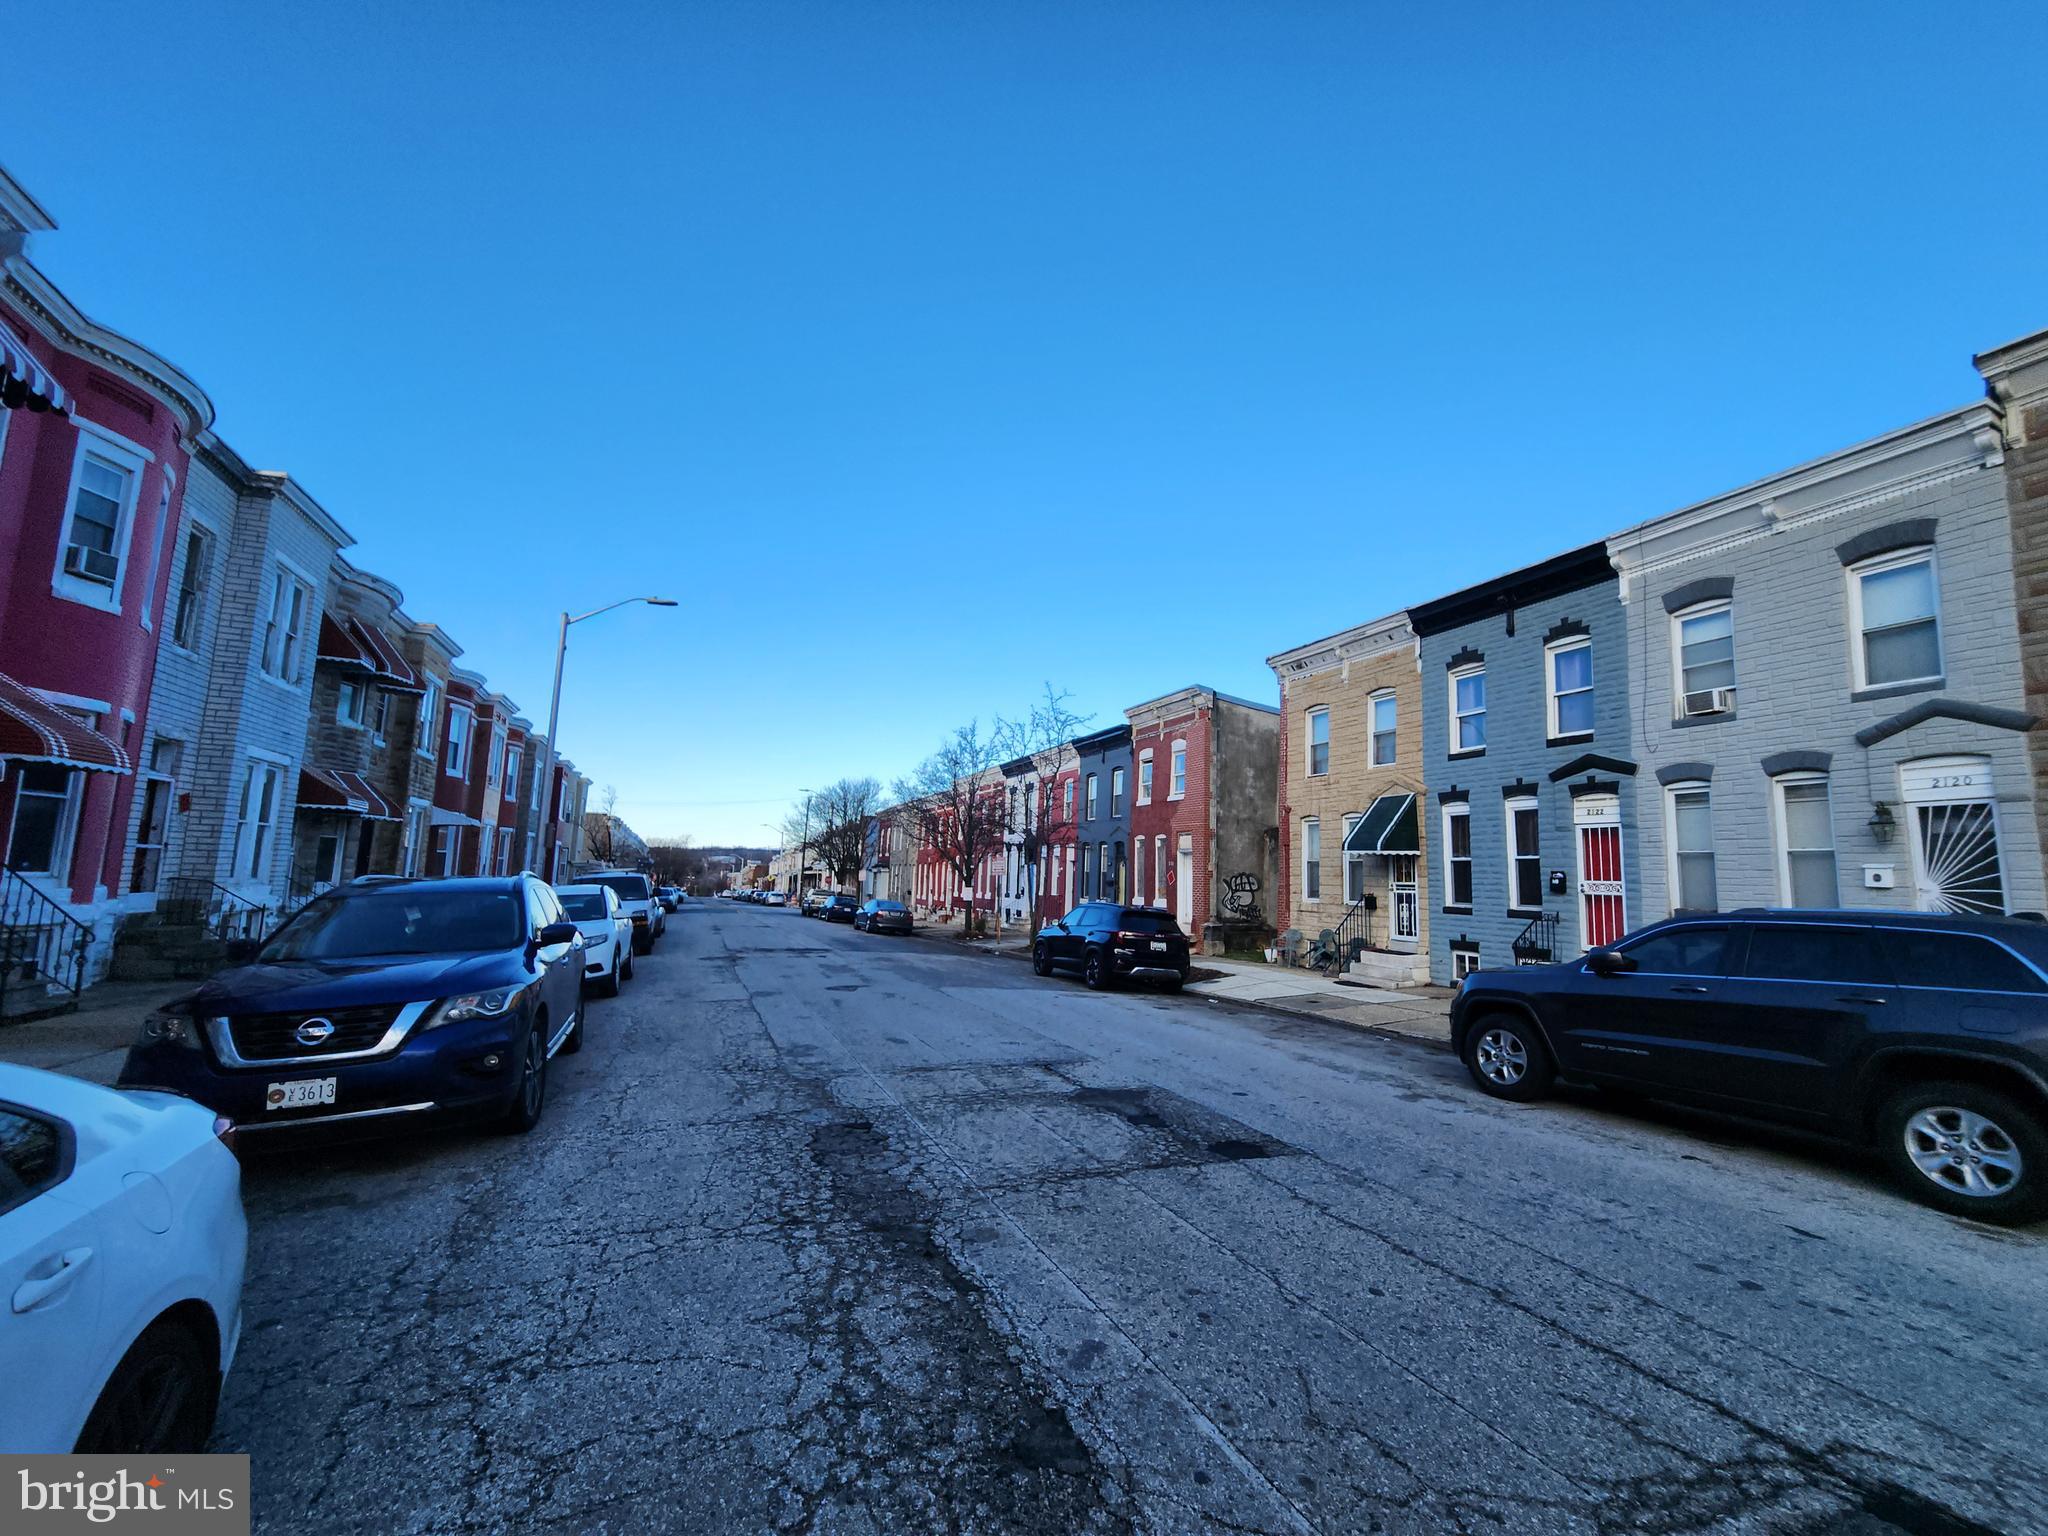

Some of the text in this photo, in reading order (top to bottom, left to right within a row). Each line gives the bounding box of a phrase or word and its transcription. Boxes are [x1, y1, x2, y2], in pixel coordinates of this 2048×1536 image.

[1932, 775, 1973, 789] 2120
[1586, 808, 1605, 816] 2122
[298, 1083, 335, 1101] 3613
